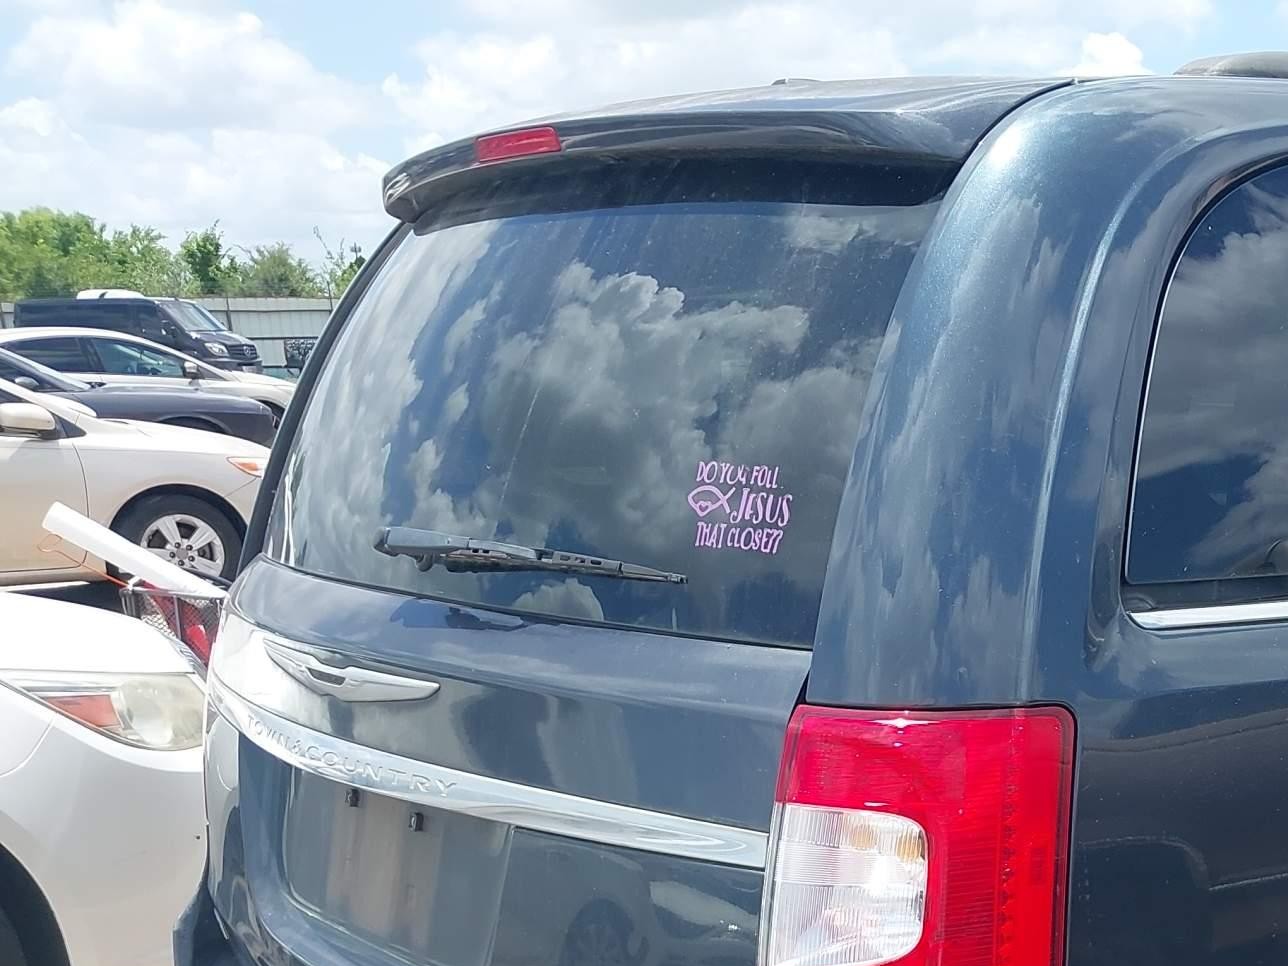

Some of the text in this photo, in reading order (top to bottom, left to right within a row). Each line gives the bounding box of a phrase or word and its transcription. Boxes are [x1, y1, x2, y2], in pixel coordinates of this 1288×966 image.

[696, 461, 718, 483] DO
[730, 488, 792, 527] JESUS
[695, 522, 727, 548] THAT
